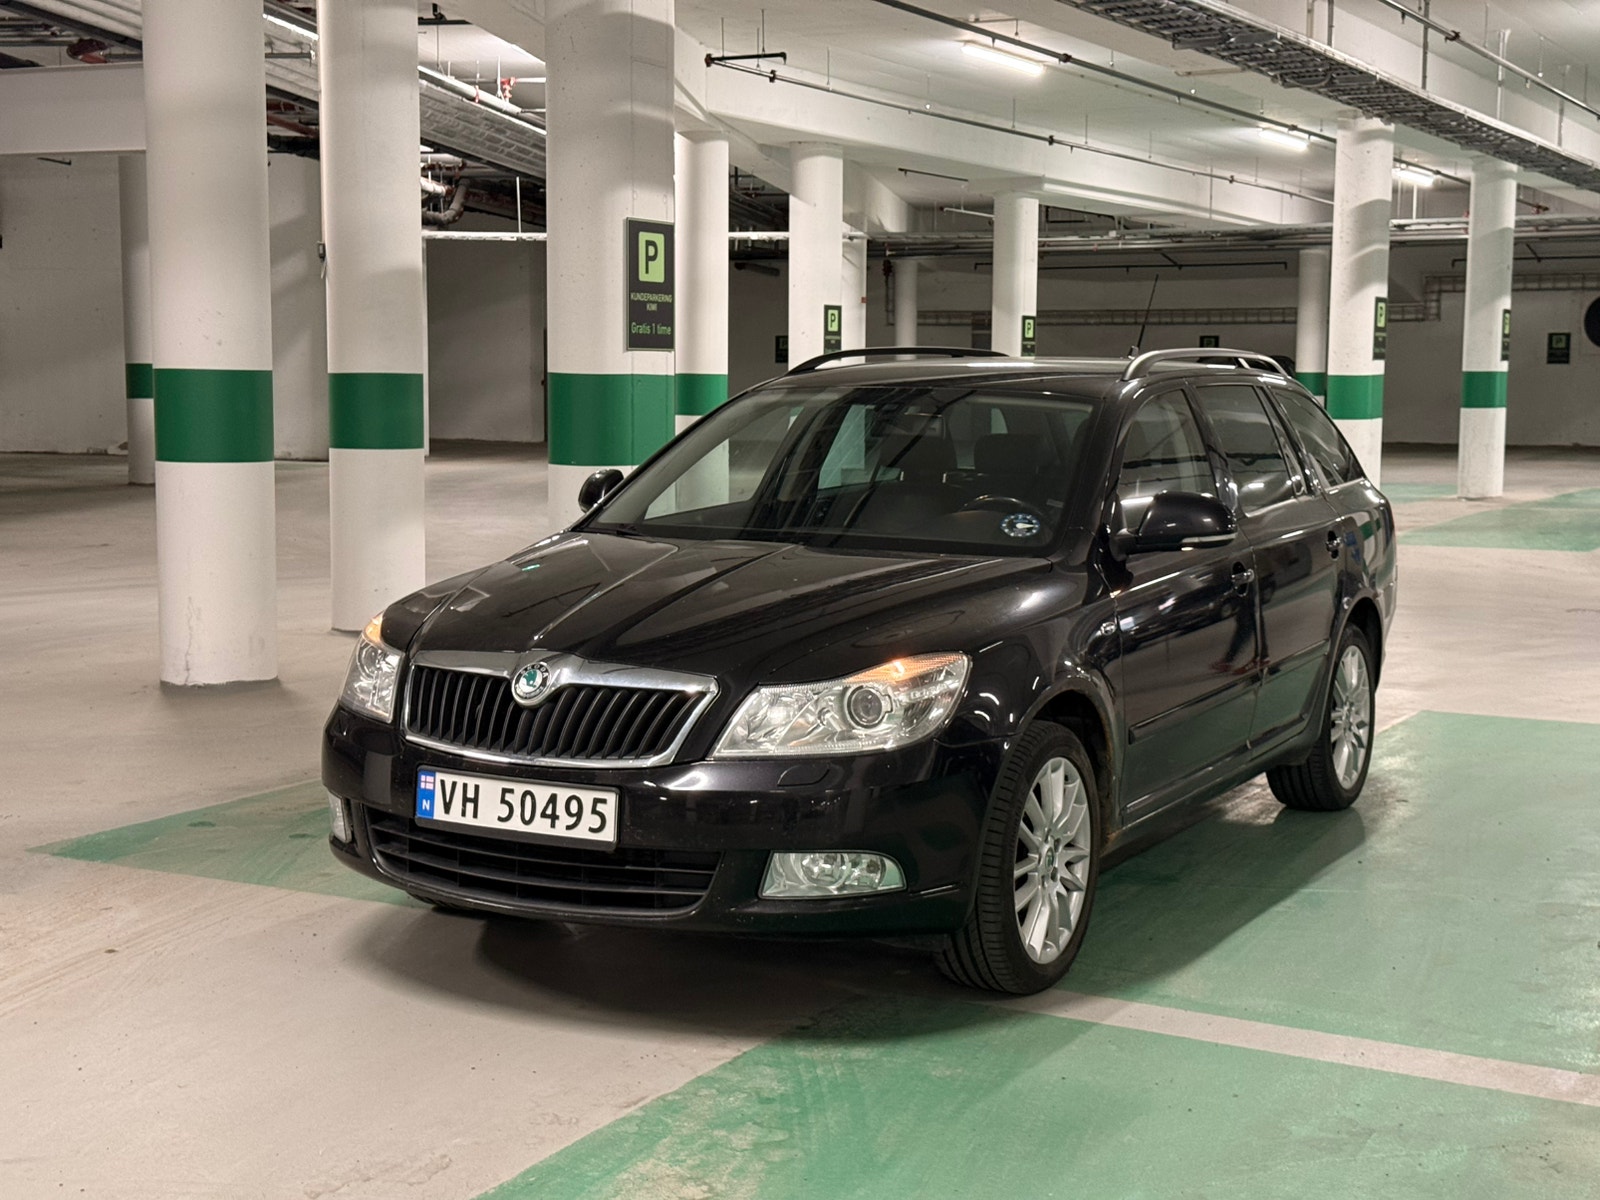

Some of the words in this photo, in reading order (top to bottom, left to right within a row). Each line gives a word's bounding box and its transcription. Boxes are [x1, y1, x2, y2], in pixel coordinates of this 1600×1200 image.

[645, 239, 659, 275] P
[630, 292, 673, 303] KUNDEPARKERING
[830, 312, 836, 329] P
[631, 321, 651, 335] Gratis
[652, 322, 656, 335] 1
[657, 322, 672, 336] time
[1027, 322, 1032, 335] P
[422, 799, 430, 811] N
[440, 779, 480, 819] VH
[497, 787, 608, 834] 50495
